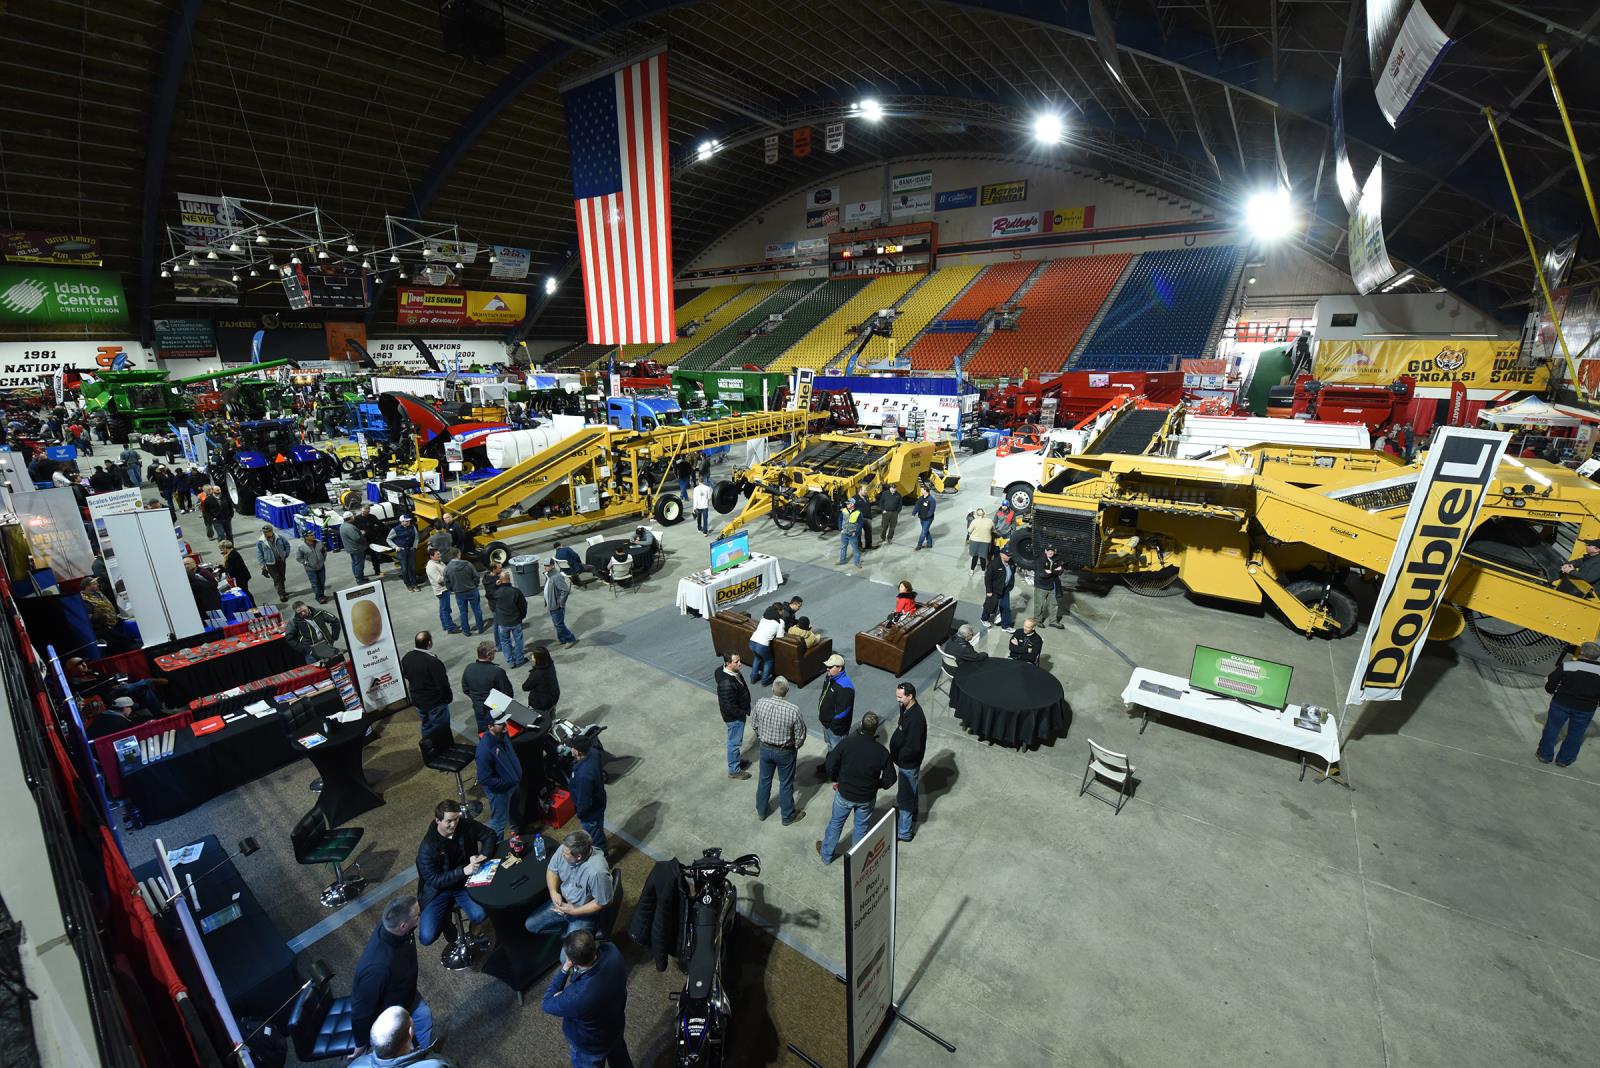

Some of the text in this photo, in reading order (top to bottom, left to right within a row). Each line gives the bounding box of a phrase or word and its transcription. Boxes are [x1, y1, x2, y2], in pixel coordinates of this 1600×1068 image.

[180, 201, 214, 215] LOCAL
[182, 213, 215, 224] NEWS
[992, 216, 1039, 233] Ridley's
[857, 267, 892, 275] BENGAL
[54, 282, 100, 294] Idaho
[57, 294, 118, 306] Central
[436, 296, 462, 304] SCHWAB
[24, 350, 56, 360] 1981
[1408, 360, 1432, 372] GO
[1490, 371, 1536, 384] STATE
